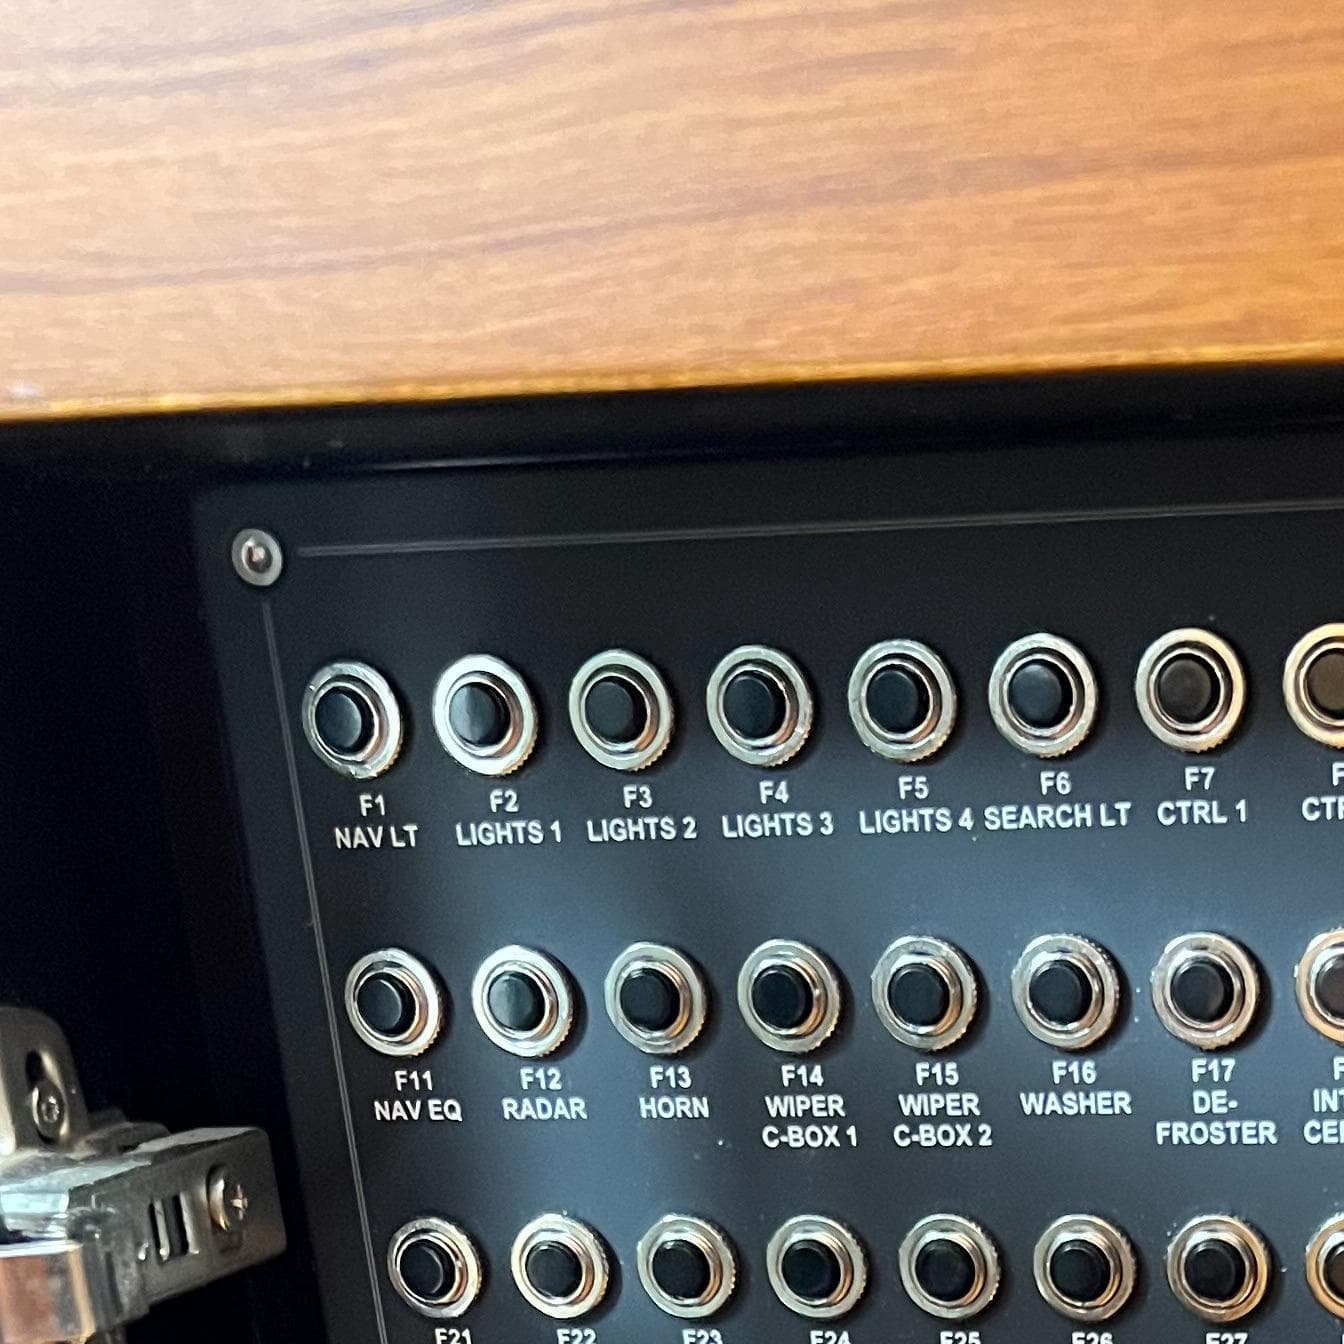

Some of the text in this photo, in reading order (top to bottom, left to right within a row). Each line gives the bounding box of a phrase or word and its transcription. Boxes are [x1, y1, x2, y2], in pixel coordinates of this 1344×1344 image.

[898, 775, 929, 800] F5
[1040, 770, 1072, 796] F6
[1184, 766, 1216, 791] F7
[489, 788, 519, 813] F2
[622, 784, 653, 809] F3
[759, 780, 790, 804] F4
[359, 793, 386, 817] F1
[984, 801, 1132, 831] SEARCH LT
[1157, 798, 1247, 826] CTRL 1
[455, 819, 562, 846] LIGHTS 1
[586, 815, 697, 842] LIGHTS 2
[721, 811, 834, 838] LIGHTS 3
[859, 807, 974, 834] LIGHTS 4
[334, 823, 419, 849] NAV LT
[394, 1070, 433, 1092] F11
[519, 1066, 563, 1090] F12
[649, 1064, 692, 1089] F13
[781, 1064, 824, 1087] F14
[915, 1061, 960, 1086] F15
[1052, 1059, 1097, 1085] F16
[1191, 1057, 1236, 1083] F17
[373, 1098, 463, 1122] NAV EQ
[501, 1096, 588, 1120] RADAR
[638, 1095, 710, 1119] HORN
[764, 1093, 846, 1118] WIPER
[898, 1092, 981, 1117] WIPER
[1019, 1090, 1132, 1116] WASHER
[1192, 1089, 1239, 1114] DE-
[761, 1124, 857, 1148] C-BOX 1
[893, 1123, 993, 1147] C-BOX 2
[1155, 1119, 1278, 1145] FROSTER
